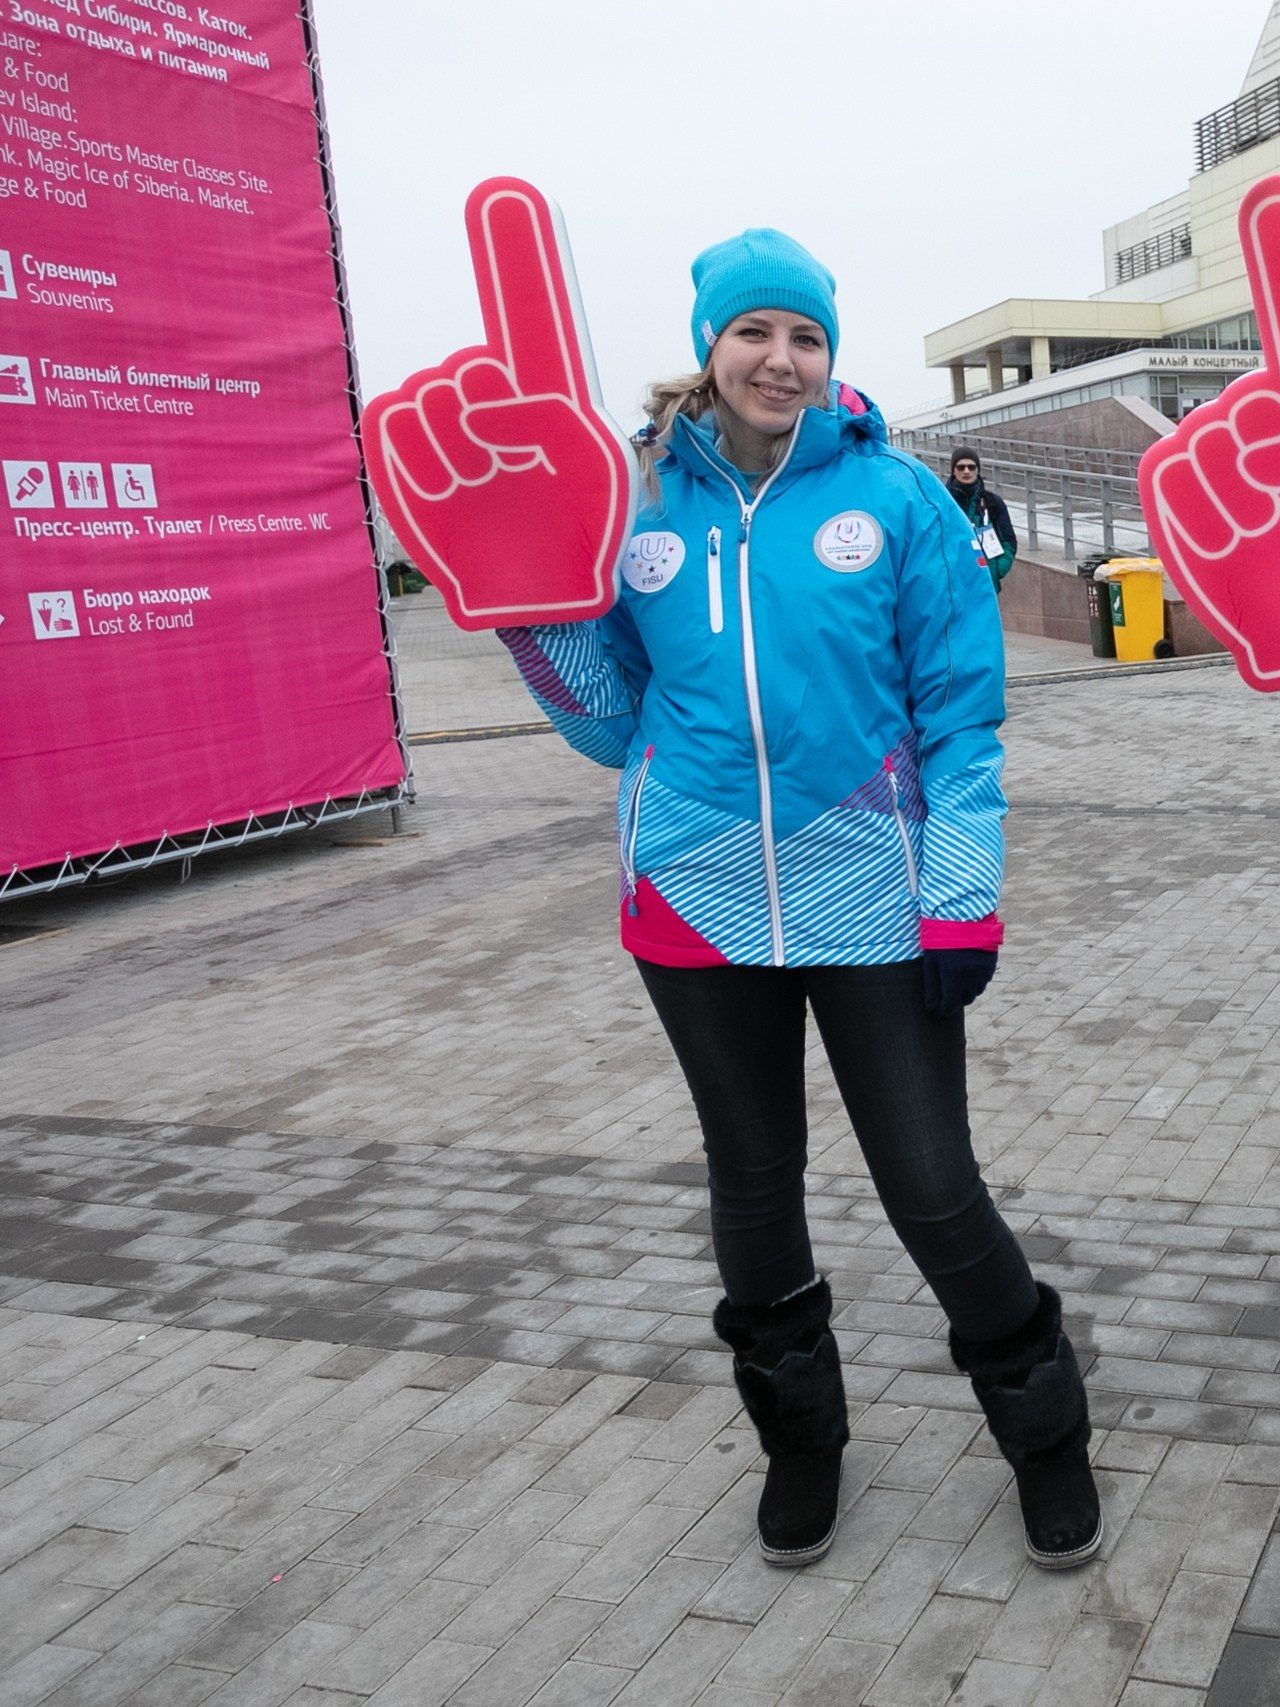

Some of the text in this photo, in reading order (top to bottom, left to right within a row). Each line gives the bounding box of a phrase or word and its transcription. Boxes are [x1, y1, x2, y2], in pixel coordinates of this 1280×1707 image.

[9, 0, 228, 82] Зона отдыха и питания
[84, 0, 158, 38] Сибири.
[163, 22, 270, 70] Ярмарочный
[198, 7, 253, 41] Каток.
[4, 56, 69, 93] & Food
[21, 89, 78, 123] Island:
[27, 148, 81, 181] Magic
[84, 162, 109, 186] Ice
[113, 170, 129, 190] of
[133, 173, 194, 203] Siberia.
[197, 186, 254, 215] Market.
[126, 144, 179, 173] Master
[182, 158, 236, 186] Classes
[238, 170, 272, 194] Site.
[24, 177, 39, 199] &
[43, 181, 87, 208] Food
[22, 254, 117, 288] Сувениры
[27, 283, 114, 313] Souvenirs
[40, 358, 261, 398] Главный билетный центр
[1149, 355, 1188, 367] МАЛЫЙ
[1193, 356, 1259, 367] КОНЦЕРТНЫЙ
[45, 387, 194, 416] Main Ticket Centre
[14, 512, 332, 541] Пресс-центр. Туалет / Press Centre. WC
[642, 574, 664, 586] FISU
[83, 586, 212, 613] Бюро находок
[88, 609, 194, 636] Lost & Found
